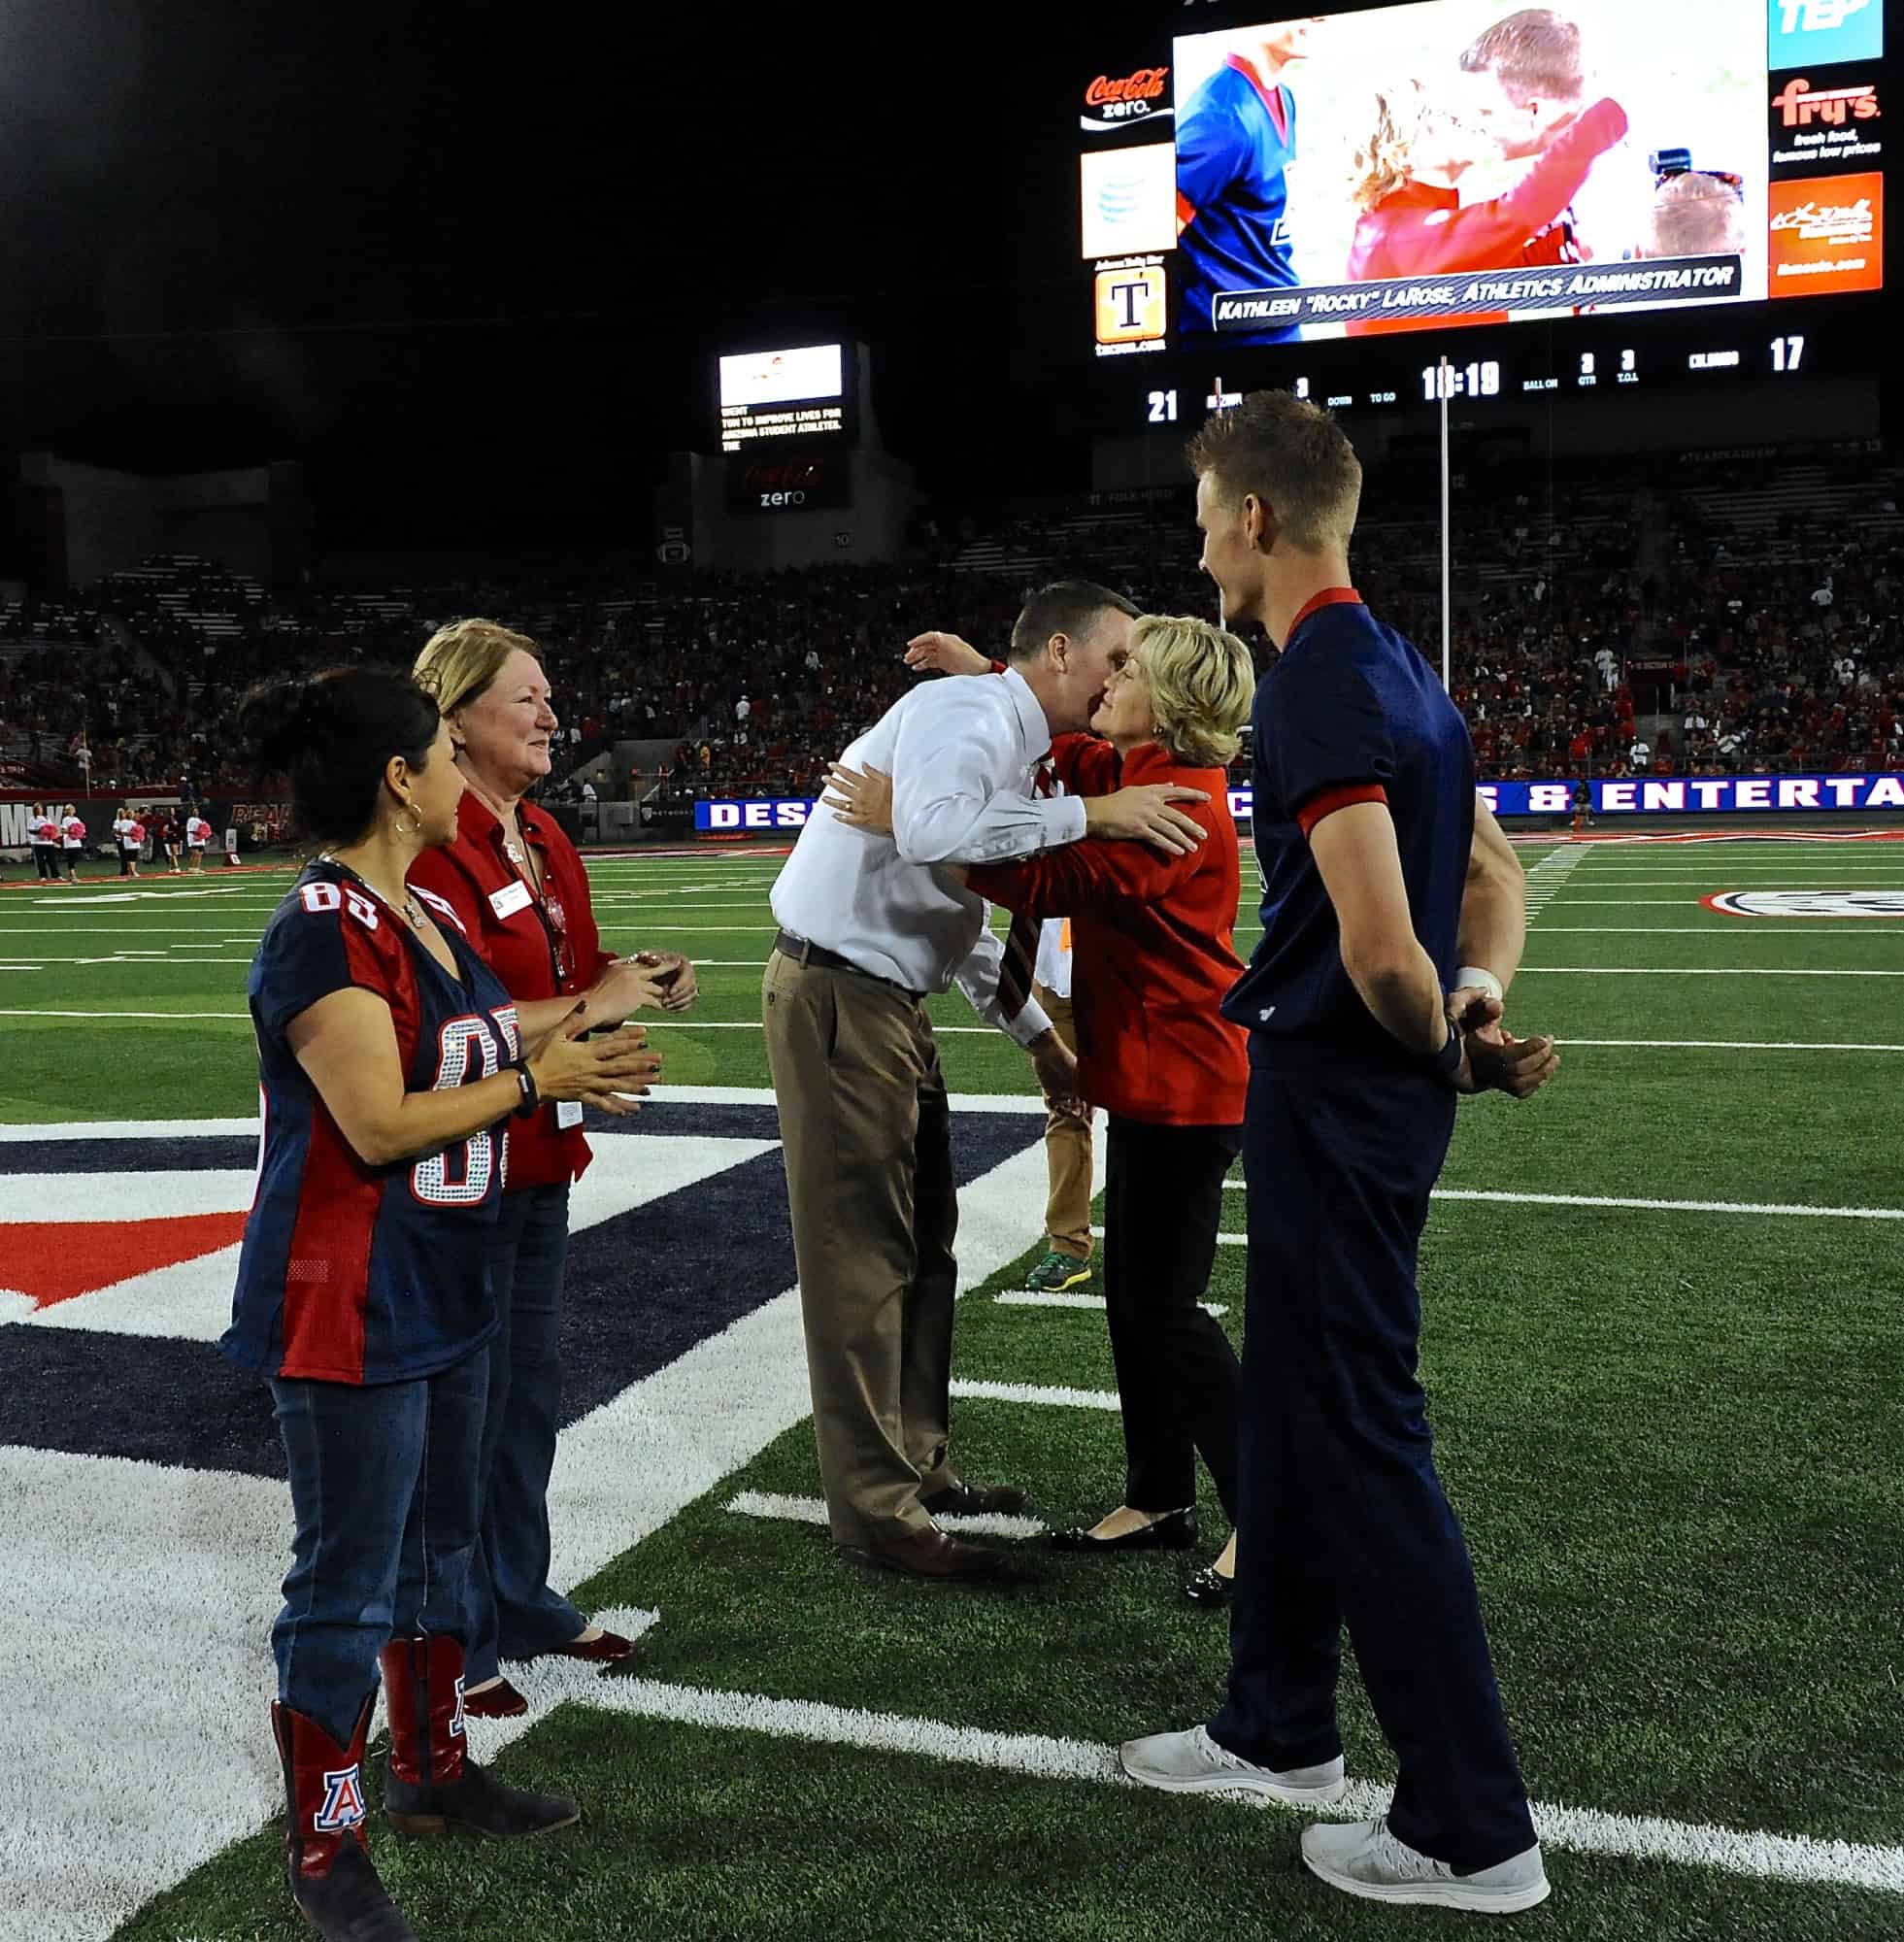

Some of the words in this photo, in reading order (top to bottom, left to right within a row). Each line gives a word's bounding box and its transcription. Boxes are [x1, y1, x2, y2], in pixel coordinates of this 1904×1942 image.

[1086, 67, 1169, 106] Coca-Cola
[1112, 282, 1149, 327] T
[1218, 298, 1301, 319] KATHLEEN
[1460, 276, 1563, 301] ATHLETICS
[1566, 266, 1734, 293] ADMINISTRATOR
[1770, 336, 1804, 371] 17
[1148, 389, 1178, 422] 21
[760, 489, 805, 507] zero
[1529, 785, 1570, 812] &
[1602, 778, 1904, 810] ENTERTA
[710, 802, 818, 827] DES
[314, 1762, 367, 1833] A
